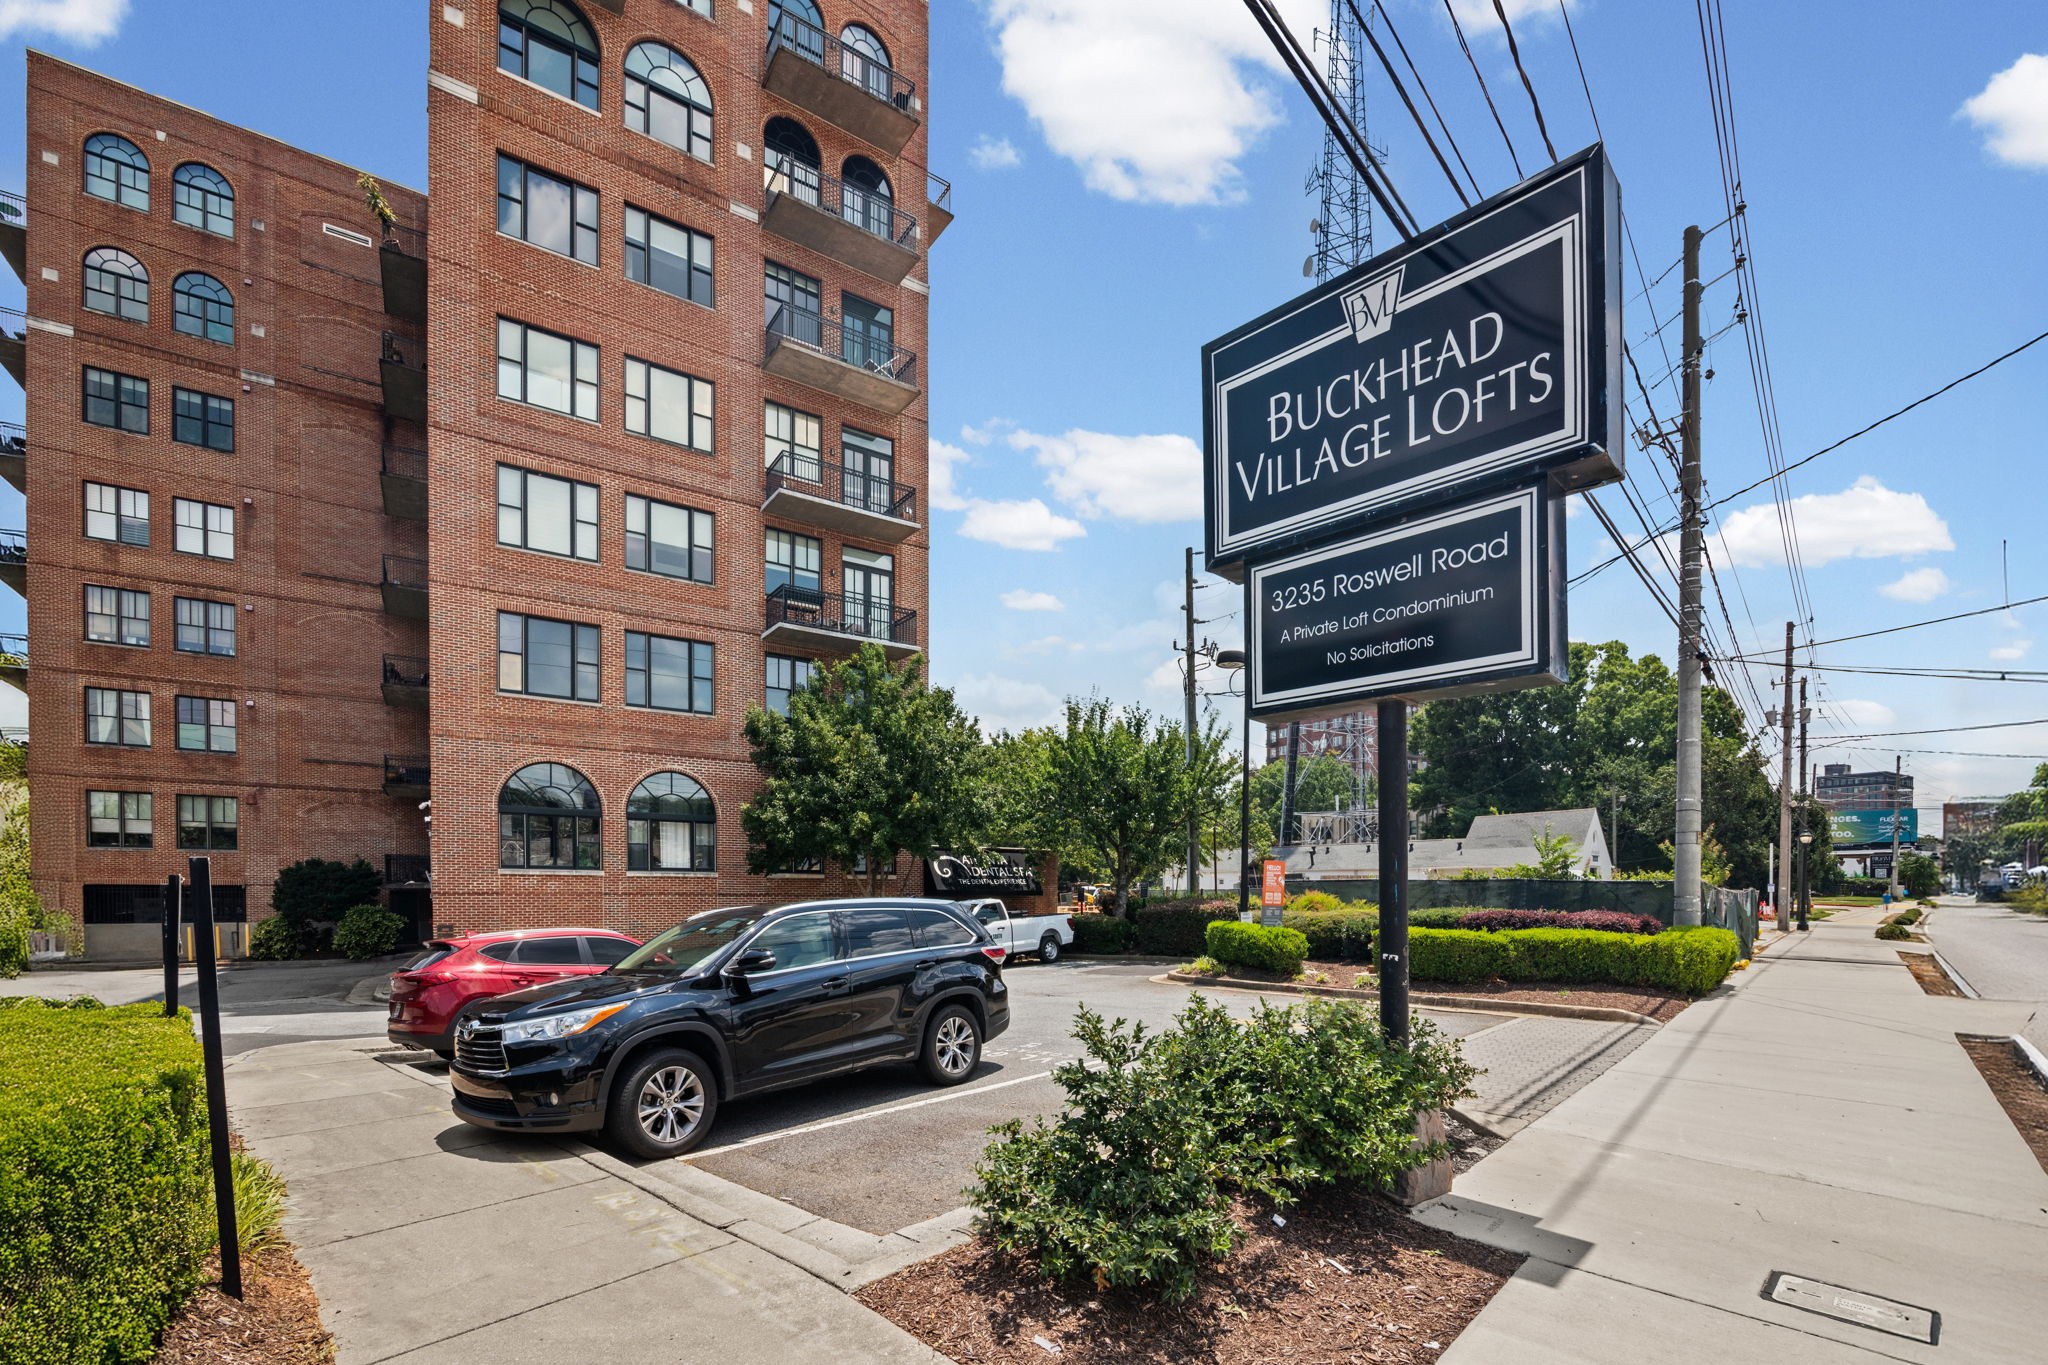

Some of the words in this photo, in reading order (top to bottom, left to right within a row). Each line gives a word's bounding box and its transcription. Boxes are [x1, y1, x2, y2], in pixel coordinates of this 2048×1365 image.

[1351, 280, 1398, 333] BVL
[1267, 312, 1503, 443] BUCKHEAD
[1236, 414, 1391, 501] VILLAGE
[1409, 352, 1553, 447] LOFTS
[1271, 579, 1326, 612] 3235
[1333, 554, 1422, 597] Roswell
[1432, 531, 1508, 573] Road
[1280, 629, 1291, 644] A
[1294, 617, 1339, 641] Private
[1343, 612, 1369, 631] Loft
[1373, 587, 1494, 624] Condominium
[1327, 650, 1346, 666] No
[1350, 634, 1434, 661] Solicitations
[1827, 815, 1861, 823] NGES.
[971, 866, 1013, 877] DENTAL
